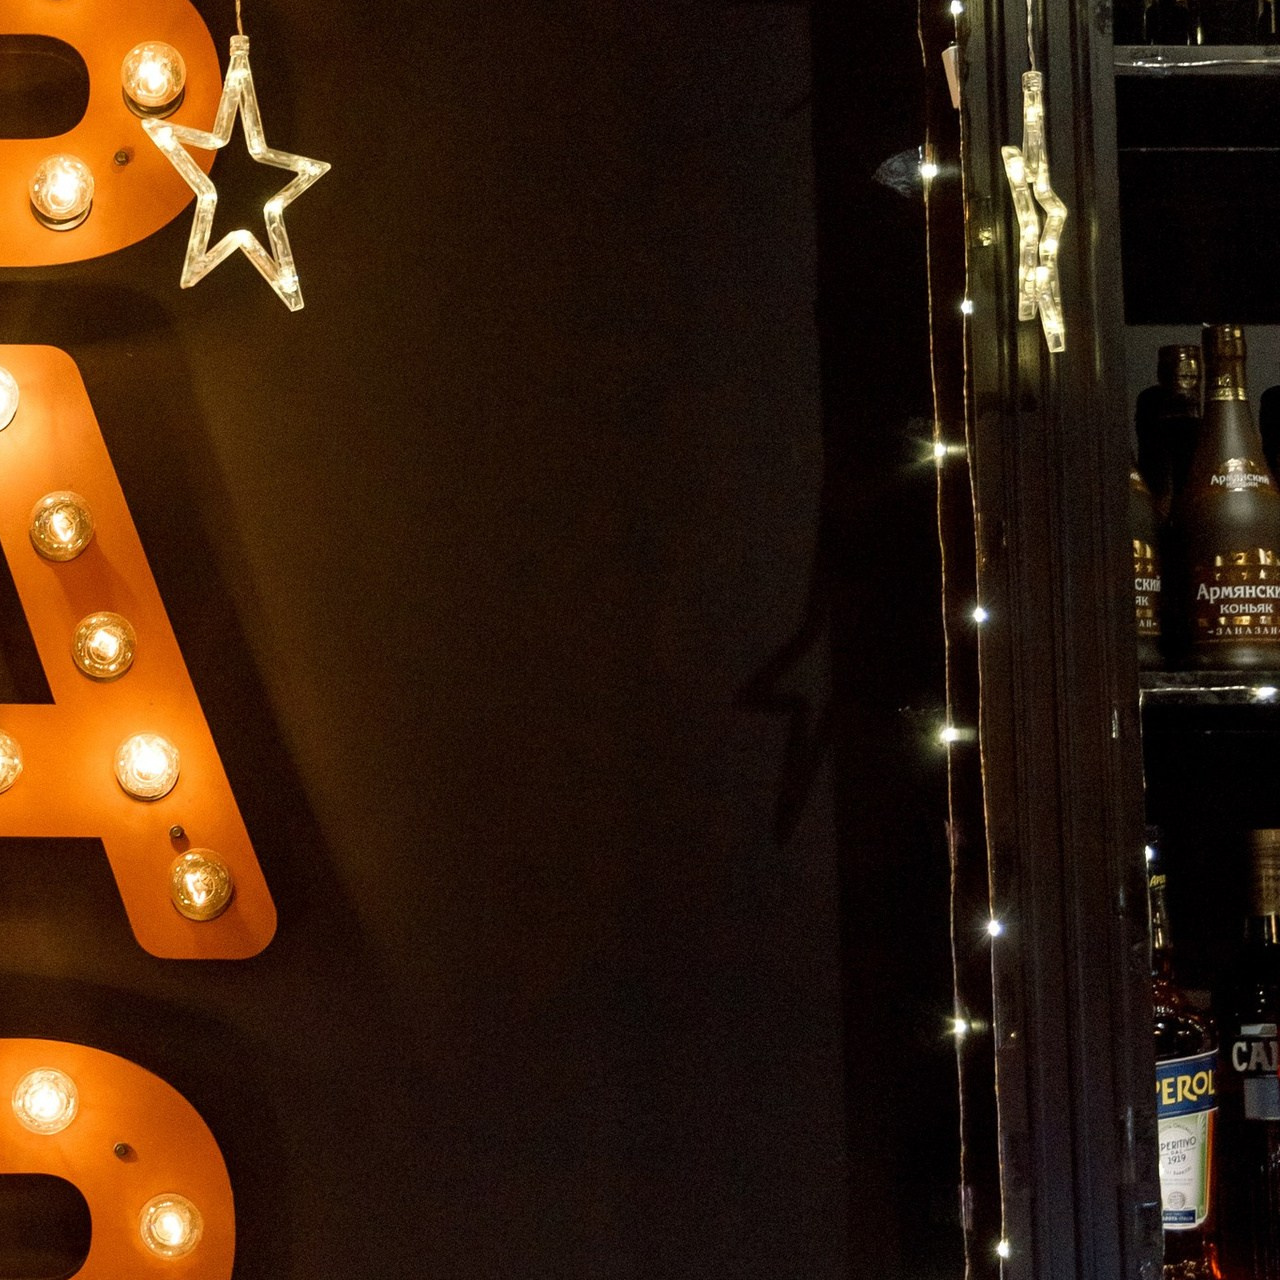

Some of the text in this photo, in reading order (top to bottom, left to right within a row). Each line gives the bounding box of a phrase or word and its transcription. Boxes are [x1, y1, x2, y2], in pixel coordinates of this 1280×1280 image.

[1196, 582, 1280, 604] Армянски
[1156, 1069, 1216, 1106] EROL
[1160, 1136, 1197, 1151] PERITIVO
[1167, 1154, 1186, 1166] 1919
